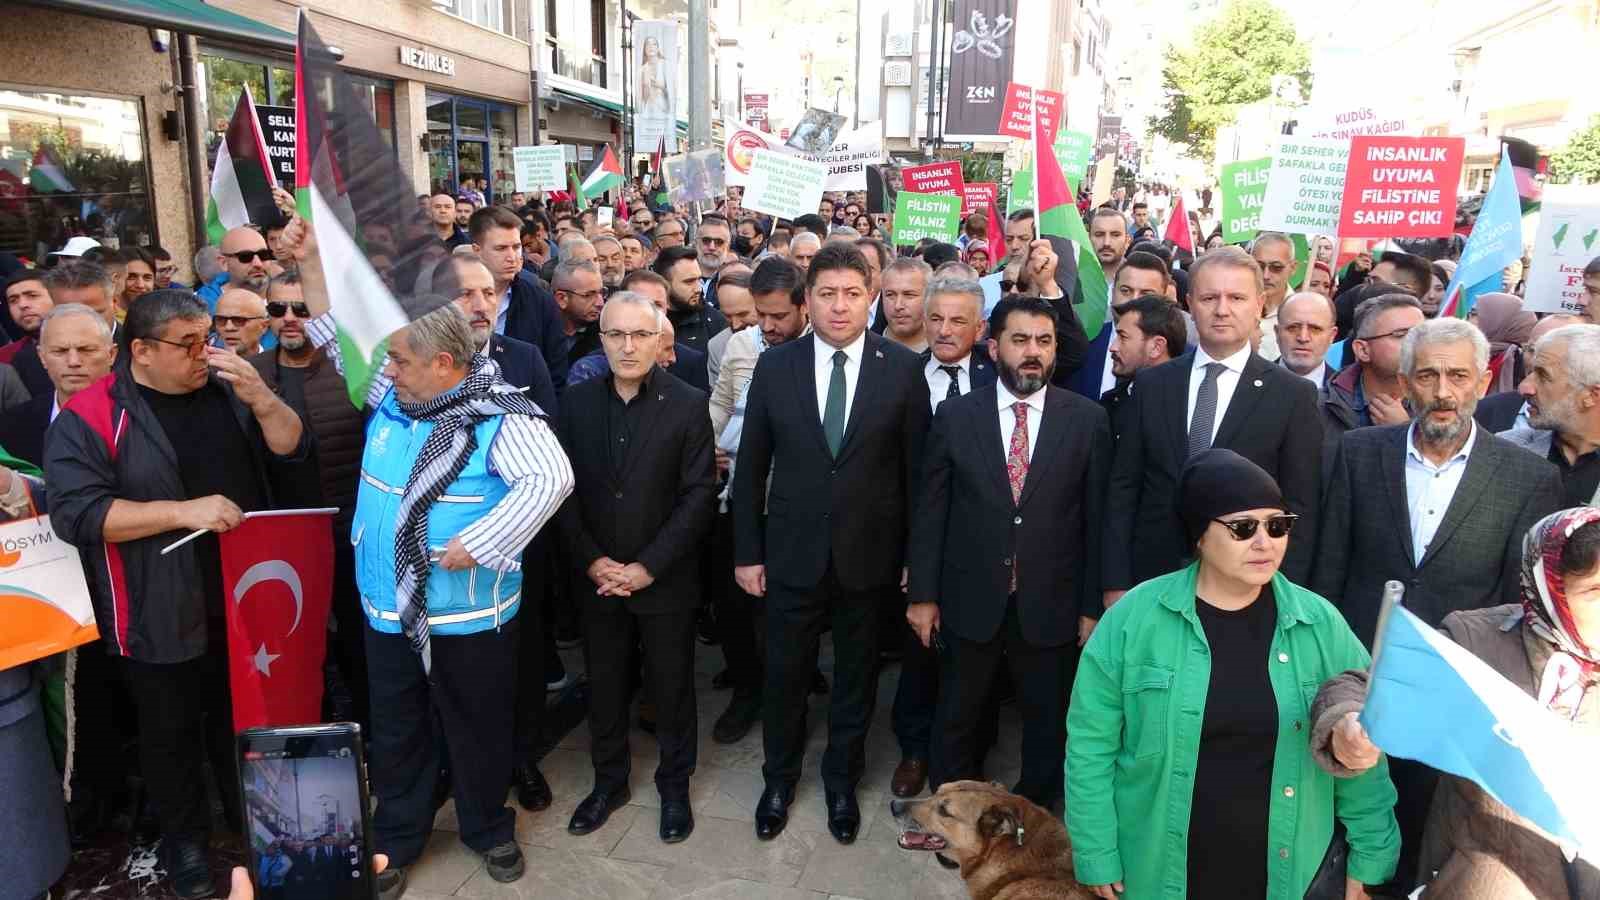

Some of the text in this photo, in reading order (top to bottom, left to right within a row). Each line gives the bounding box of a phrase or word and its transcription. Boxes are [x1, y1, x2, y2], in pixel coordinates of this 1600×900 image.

[967, 86, 995, 99] ZEN
[1366, 146, 1447, 161] İNSANLIK
[1372, 168, 1434, 182] UYUMA
[918, 179, 950, 190] UYUMA
[1361, 189, 1440, 204] FİLİSTİNE
[907, 199, 950, 213] FİLİSTİN
[908, 216, 946, 229] YALNIZ
[1353, 210, 1442, 227] SAHİP ÇIK!
[4, 531, 52, 551] ÖSYM
